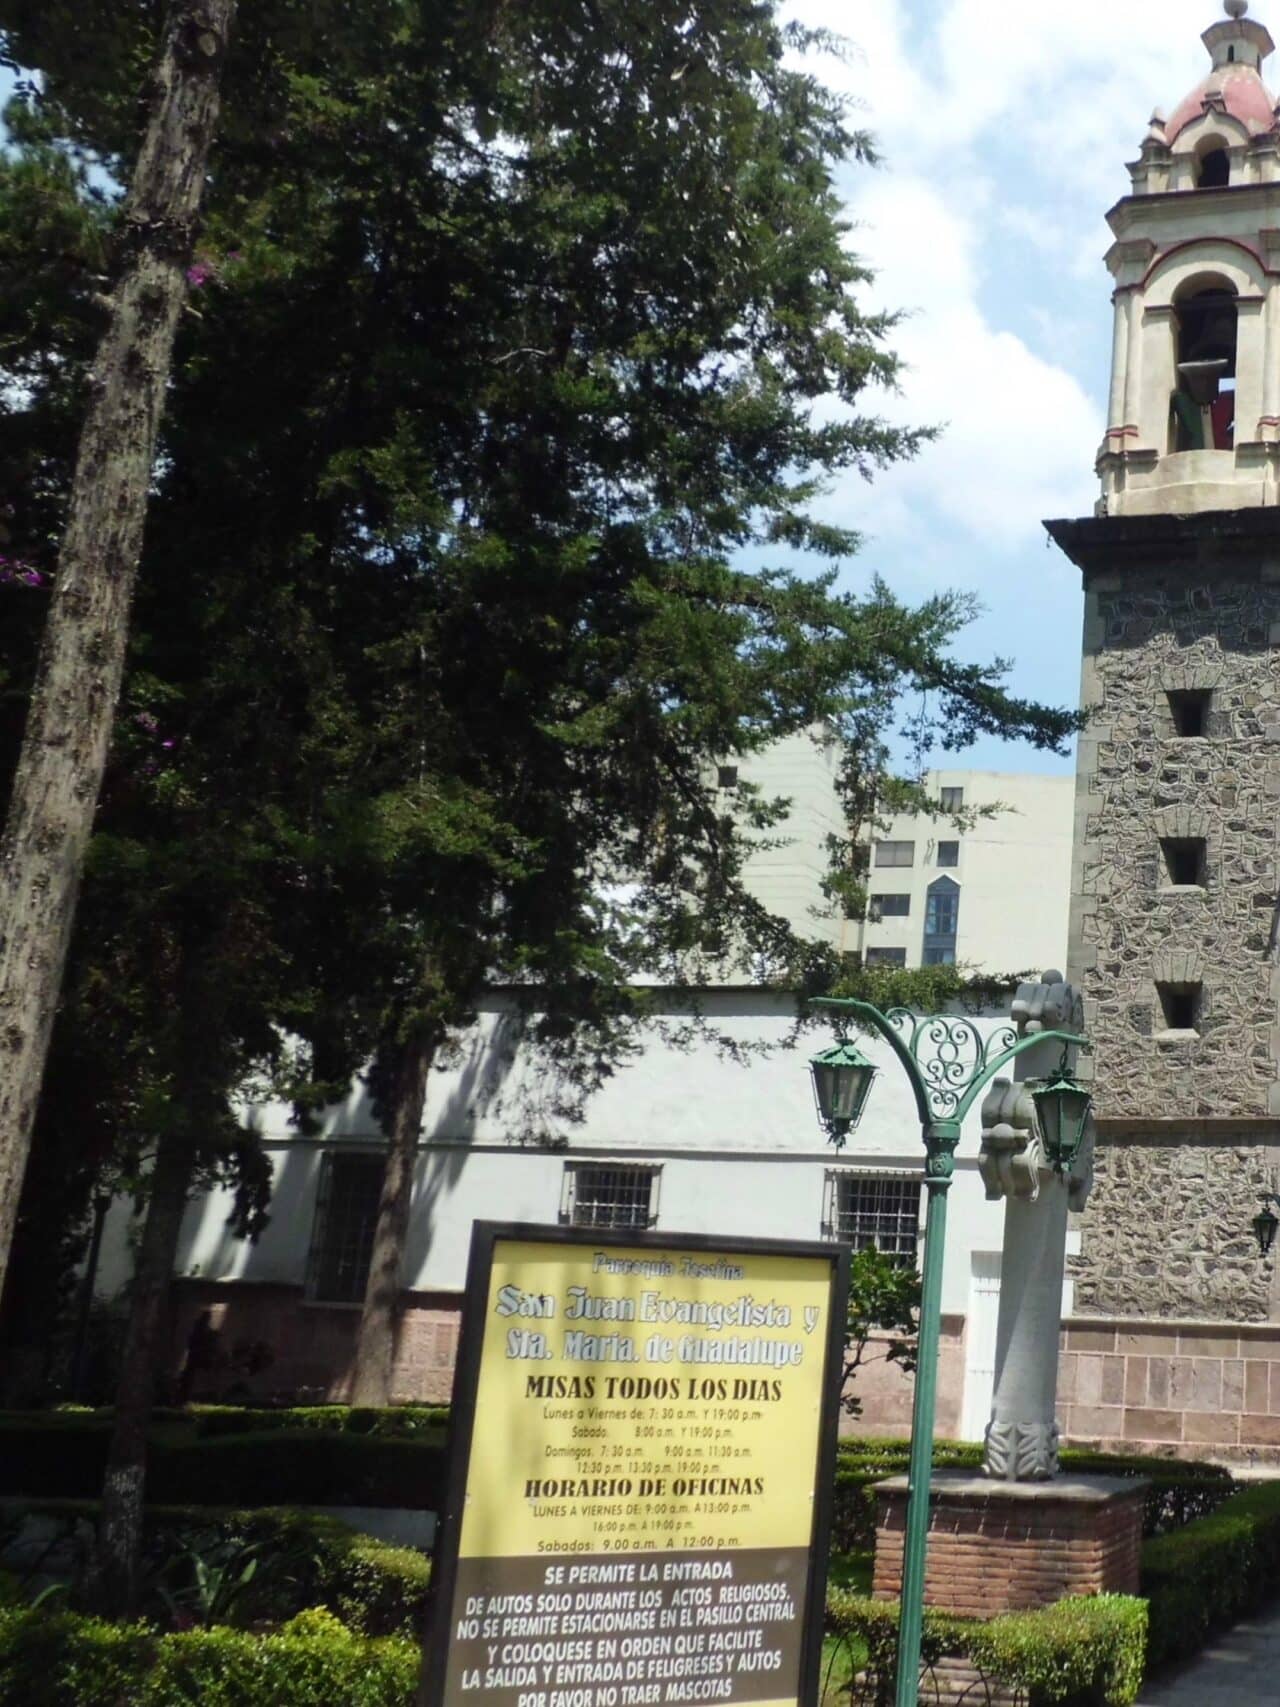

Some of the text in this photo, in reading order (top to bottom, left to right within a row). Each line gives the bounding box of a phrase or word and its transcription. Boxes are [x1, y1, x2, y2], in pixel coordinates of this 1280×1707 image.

[593, 1251, 674, 1280] Parroquia
[495, 1283, 820, 1334] San Juan Evangelista y
[506, 1327, 552, 1361] Sta.
[645, 1333, 674, 1363] de
[678, 1335, 805, 1369] Guadalupe
[525, 1375, 782, 1402] MISAS TODOS LOS DIAS
[543, 1407, 573, 1420] Lunes
[577, 1410, 587, 1420] a
[588, 1407, 626, 1420] Viernes
[662, 1408, 674, 1420] 30
[703, 1409, 710, 1420] Y
[713, 1409, 740, 1421] 19:00
[635, 1426, 654, 1439] 8:00
[690, 1427, 713, 1439] 19:00
[612, 1445, 623, 1457] 30
[664, 1446, 683, 1458] 9:00
[709, 1445, 732, 1458] 11:30
[577, 1461, 601, 1475] 12:30
[629, 1462, 652, 1474] 13:30
[677, 1461, 701, 1474] 19:00
[524, 1478, 764, 1498] HORARIO DE OFICINAS
[533, 1505, 567, 1518] LUNES
[569, 1505, 578, 1517] A
[581, 1503, 623, 1517] VIERNES
[646, 1503, 667, 1515] 9:00
[694, 1502, 702, 1513] A
[703, 1502, 729, 1514] 13:00
[593, 1521, 617, 1532] 16:00
[641, 1520, 648, 1531] A
[651, 1519, 674, 1531] 19:00
[666, 1537, 675, 1549] A
[684, 1536, 714, 1548] 12:00
[544, 1561, 734, 1585] SE PERMITE LA ENTRADA
[466, 1582, 791, 1616] DE AUTOS SOLO DURANTE LOS ACTOS RELIGIOSOS.
[456, 1601, 795, 1641] NO SE PERMITE ESTACIONARSE EN EL PASILLO CENTRAL
[487, 1629, 763, 1665] Y COLOQUESE EN ORDEN QUE FACILITE
[461, 1650, 782, 1690] LA SALIDA Y ENTRADA DE FELIGRESES Y AUTOS
[517, 1678, 733, 1707] POR FAVOR NO TRAER MASCOTAS
